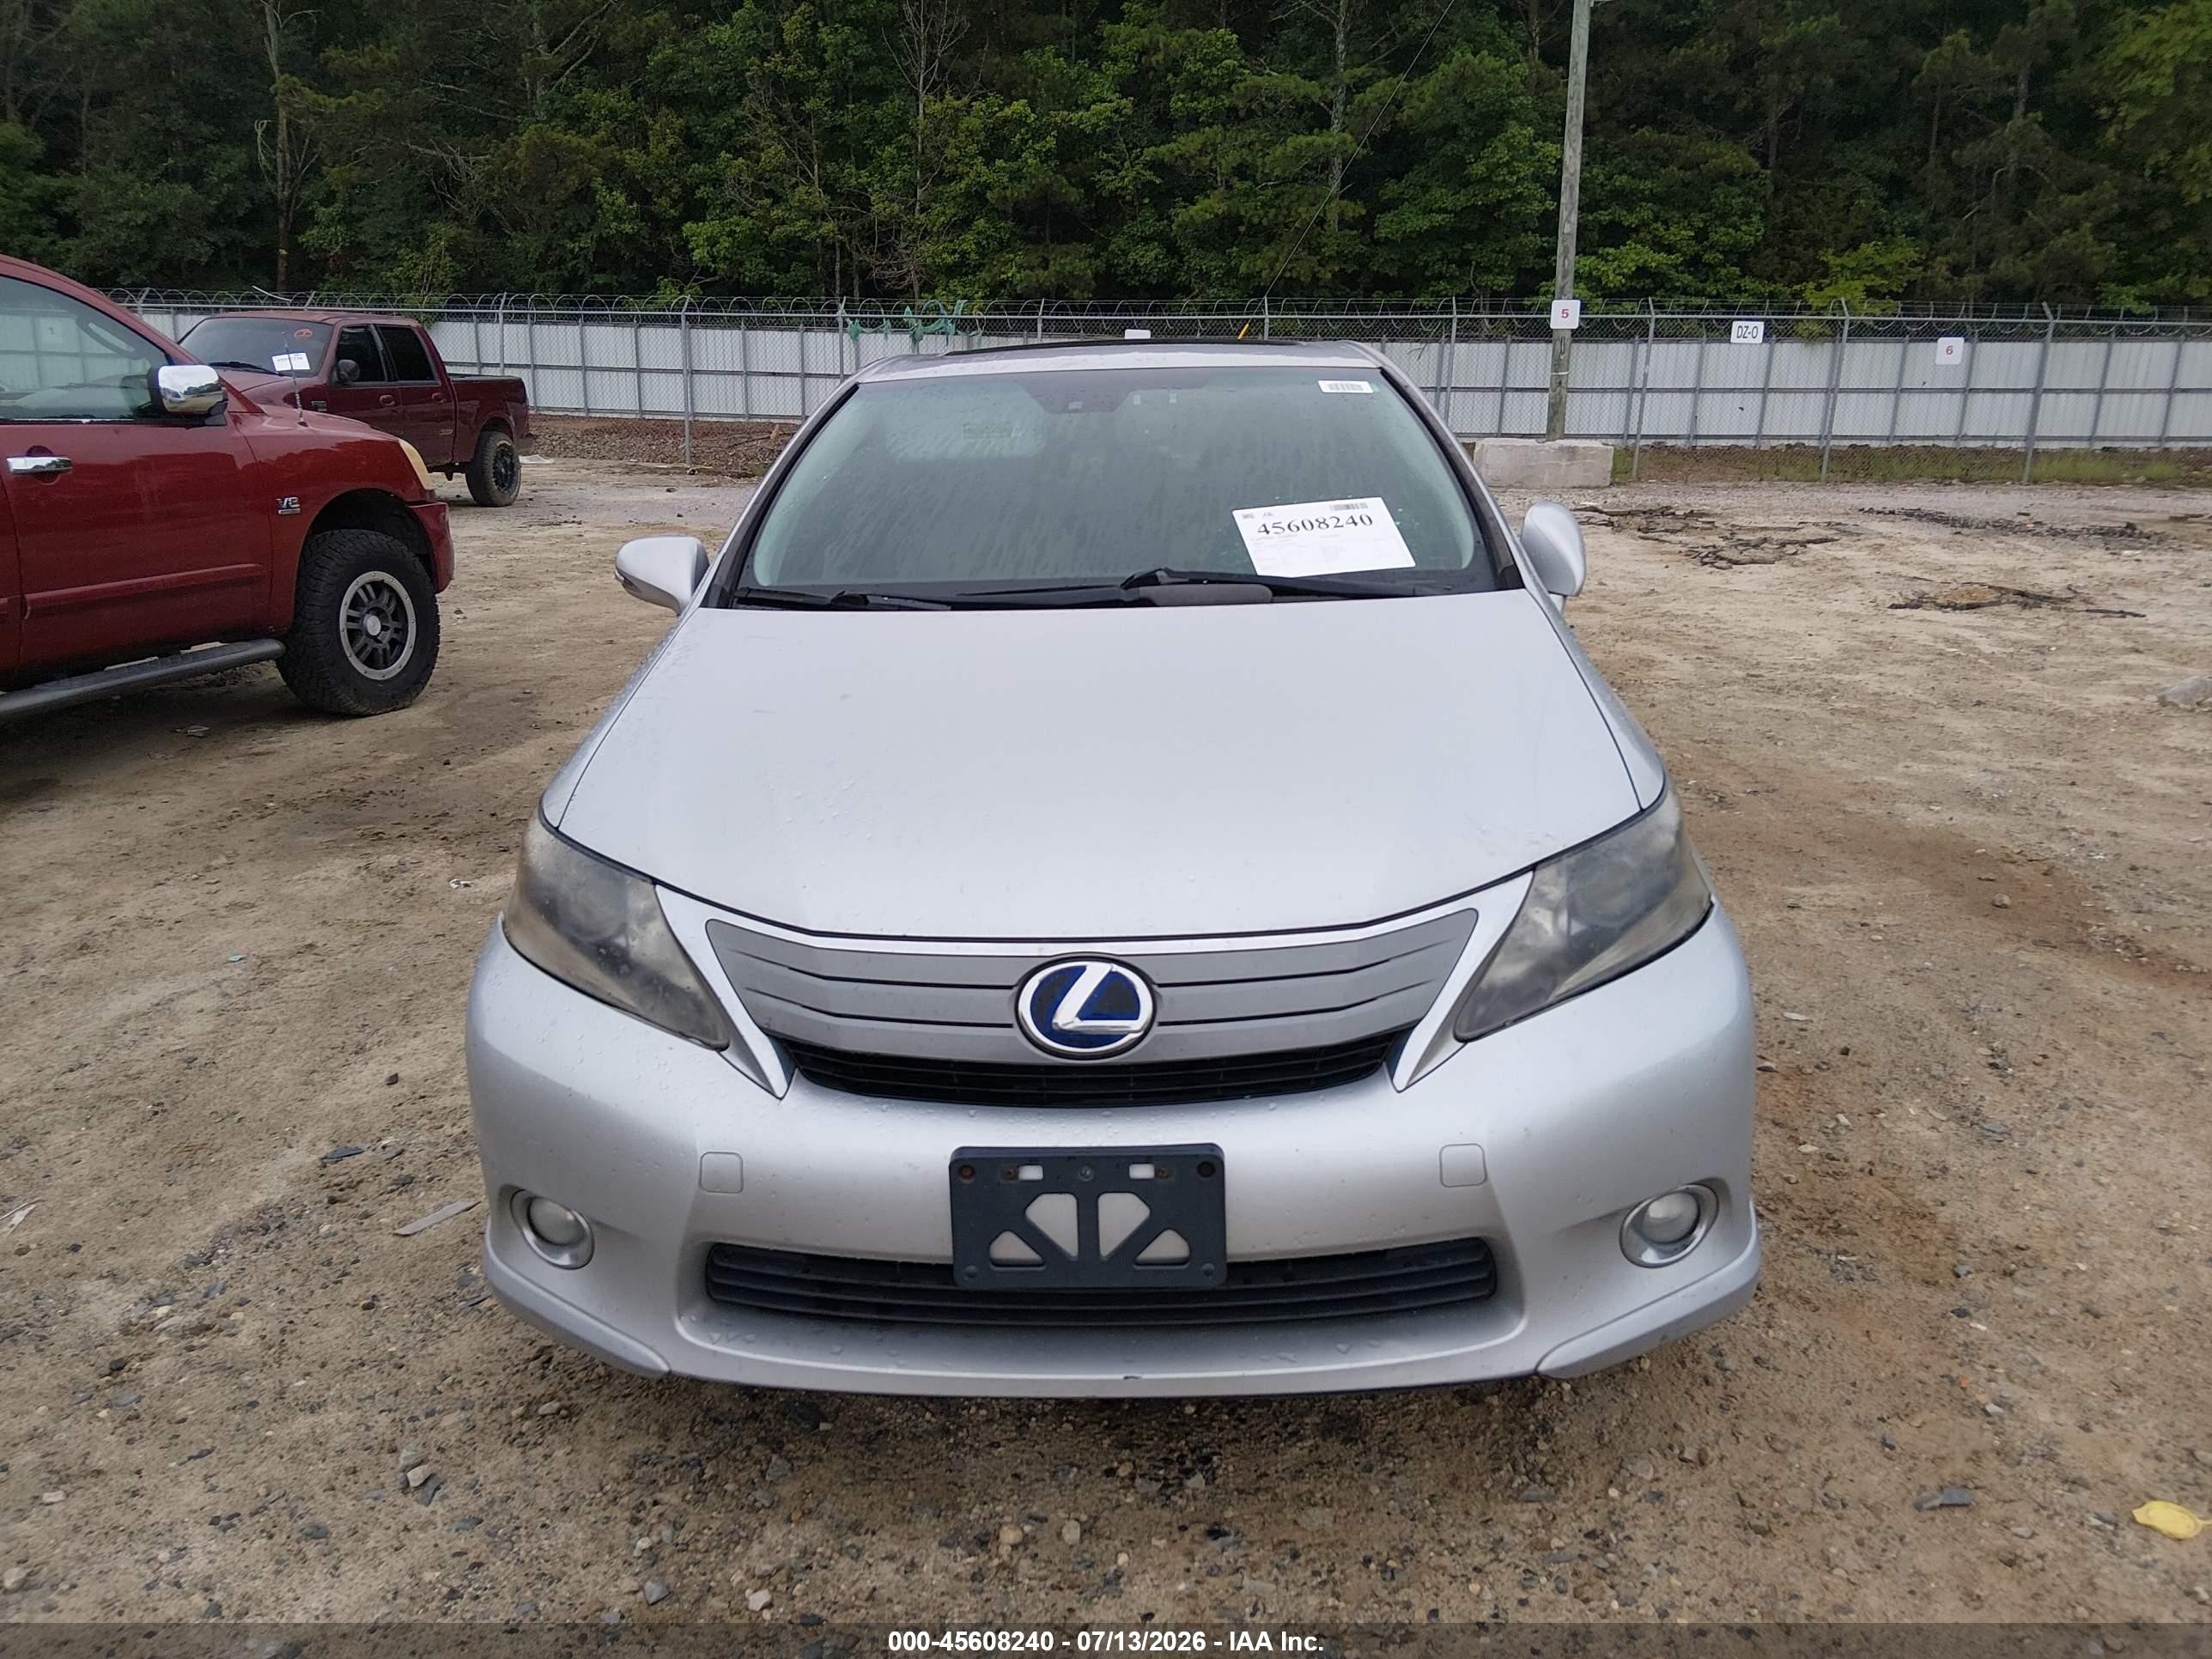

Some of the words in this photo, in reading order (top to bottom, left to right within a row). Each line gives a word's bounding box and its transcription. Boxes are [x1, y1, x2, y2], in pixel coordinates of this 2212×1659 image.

[1561, 309, 1570, 319] 5
[1946, 345, 1954, 356] 6
[1257, 514, 1373, 535] 45608240
